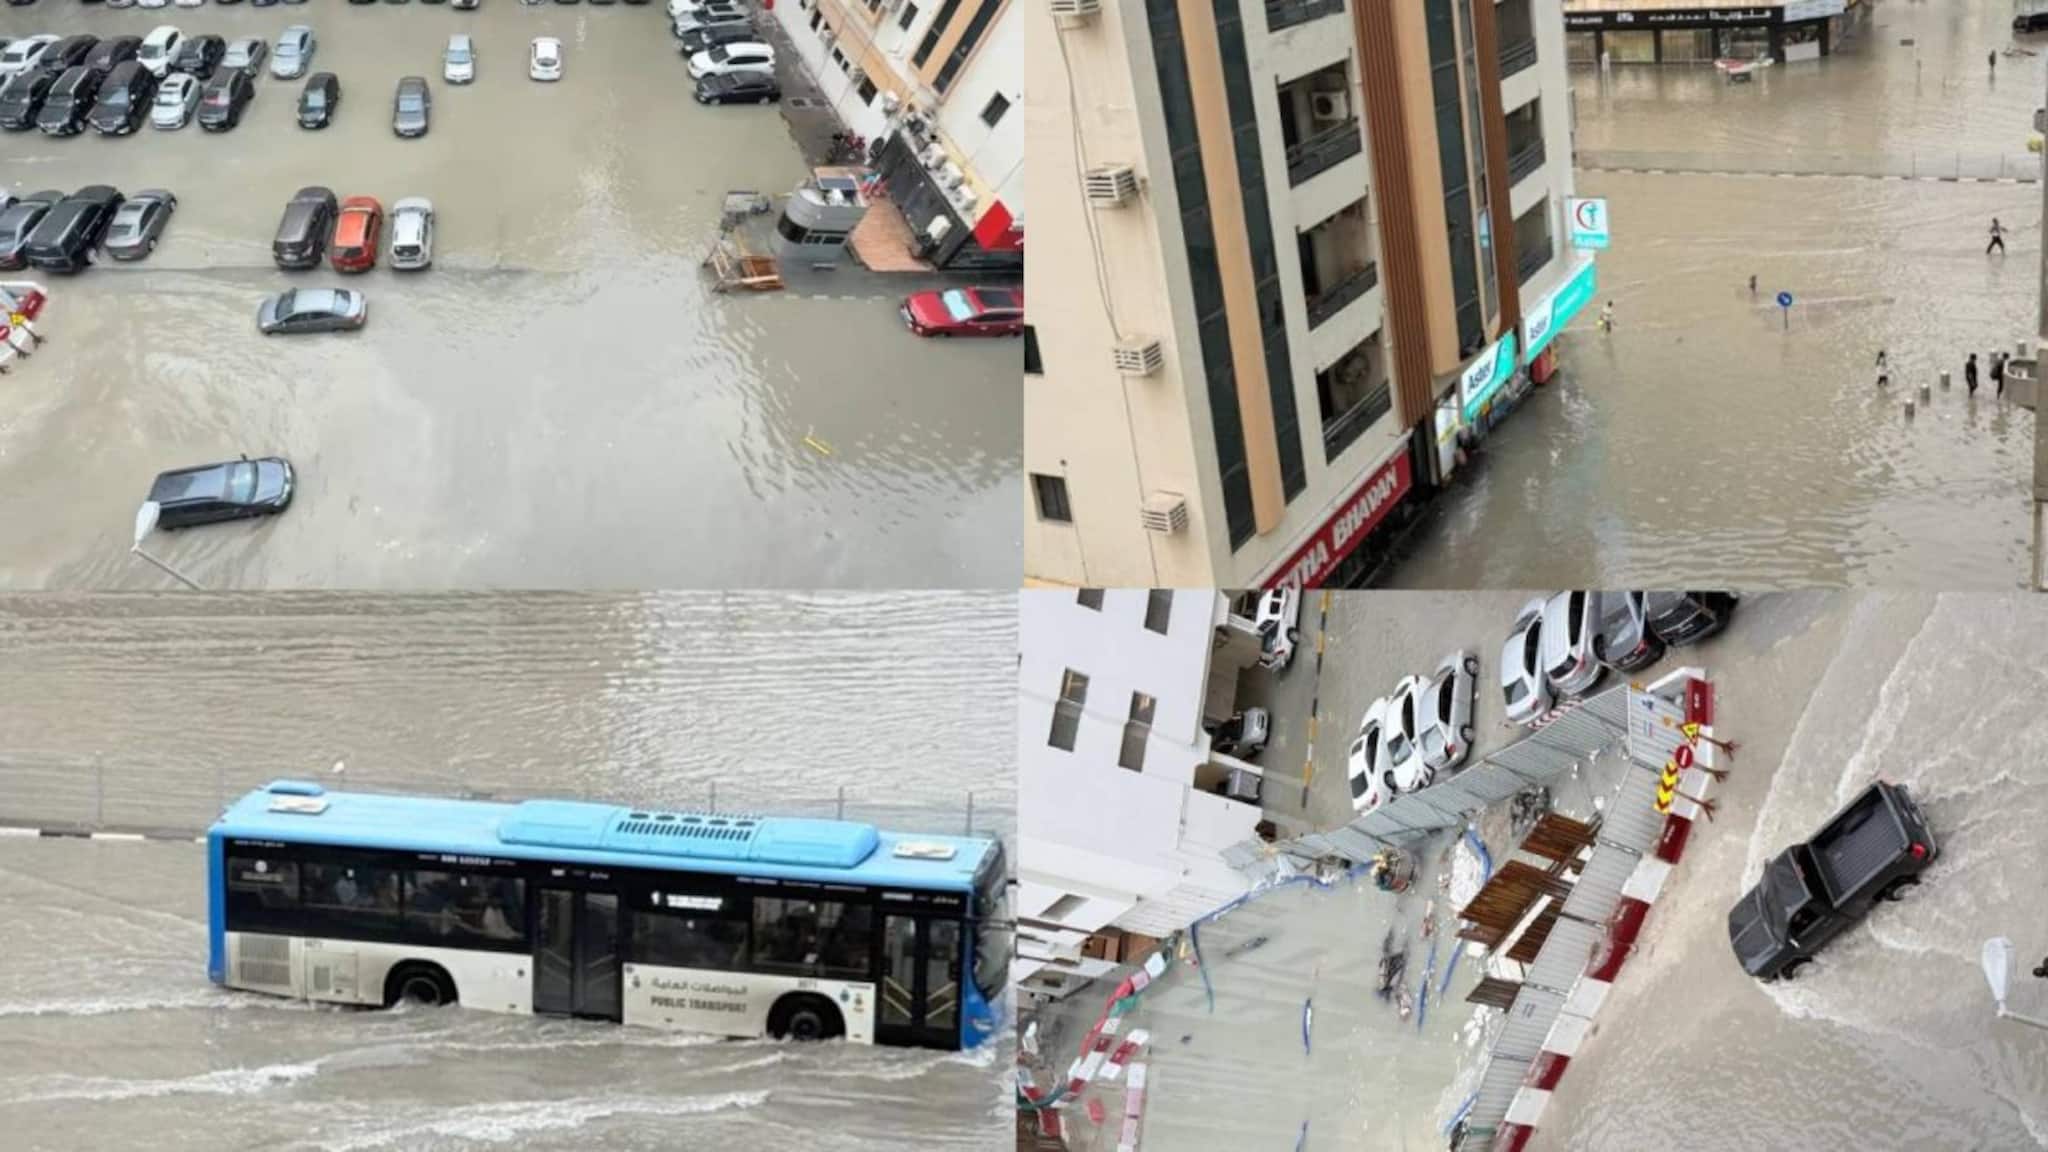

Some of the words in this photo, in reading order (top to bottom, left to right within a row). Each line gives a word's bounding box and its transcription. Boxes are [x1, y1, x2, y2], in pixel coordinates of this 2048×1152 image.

[1468, 359, 1492, 395] Aster
[1332, 464, 1398, 551] BHAVAN
[650, 996, 687, 1009] PUBLIC
[688, 998, 748, 1014] TRANSPORT
